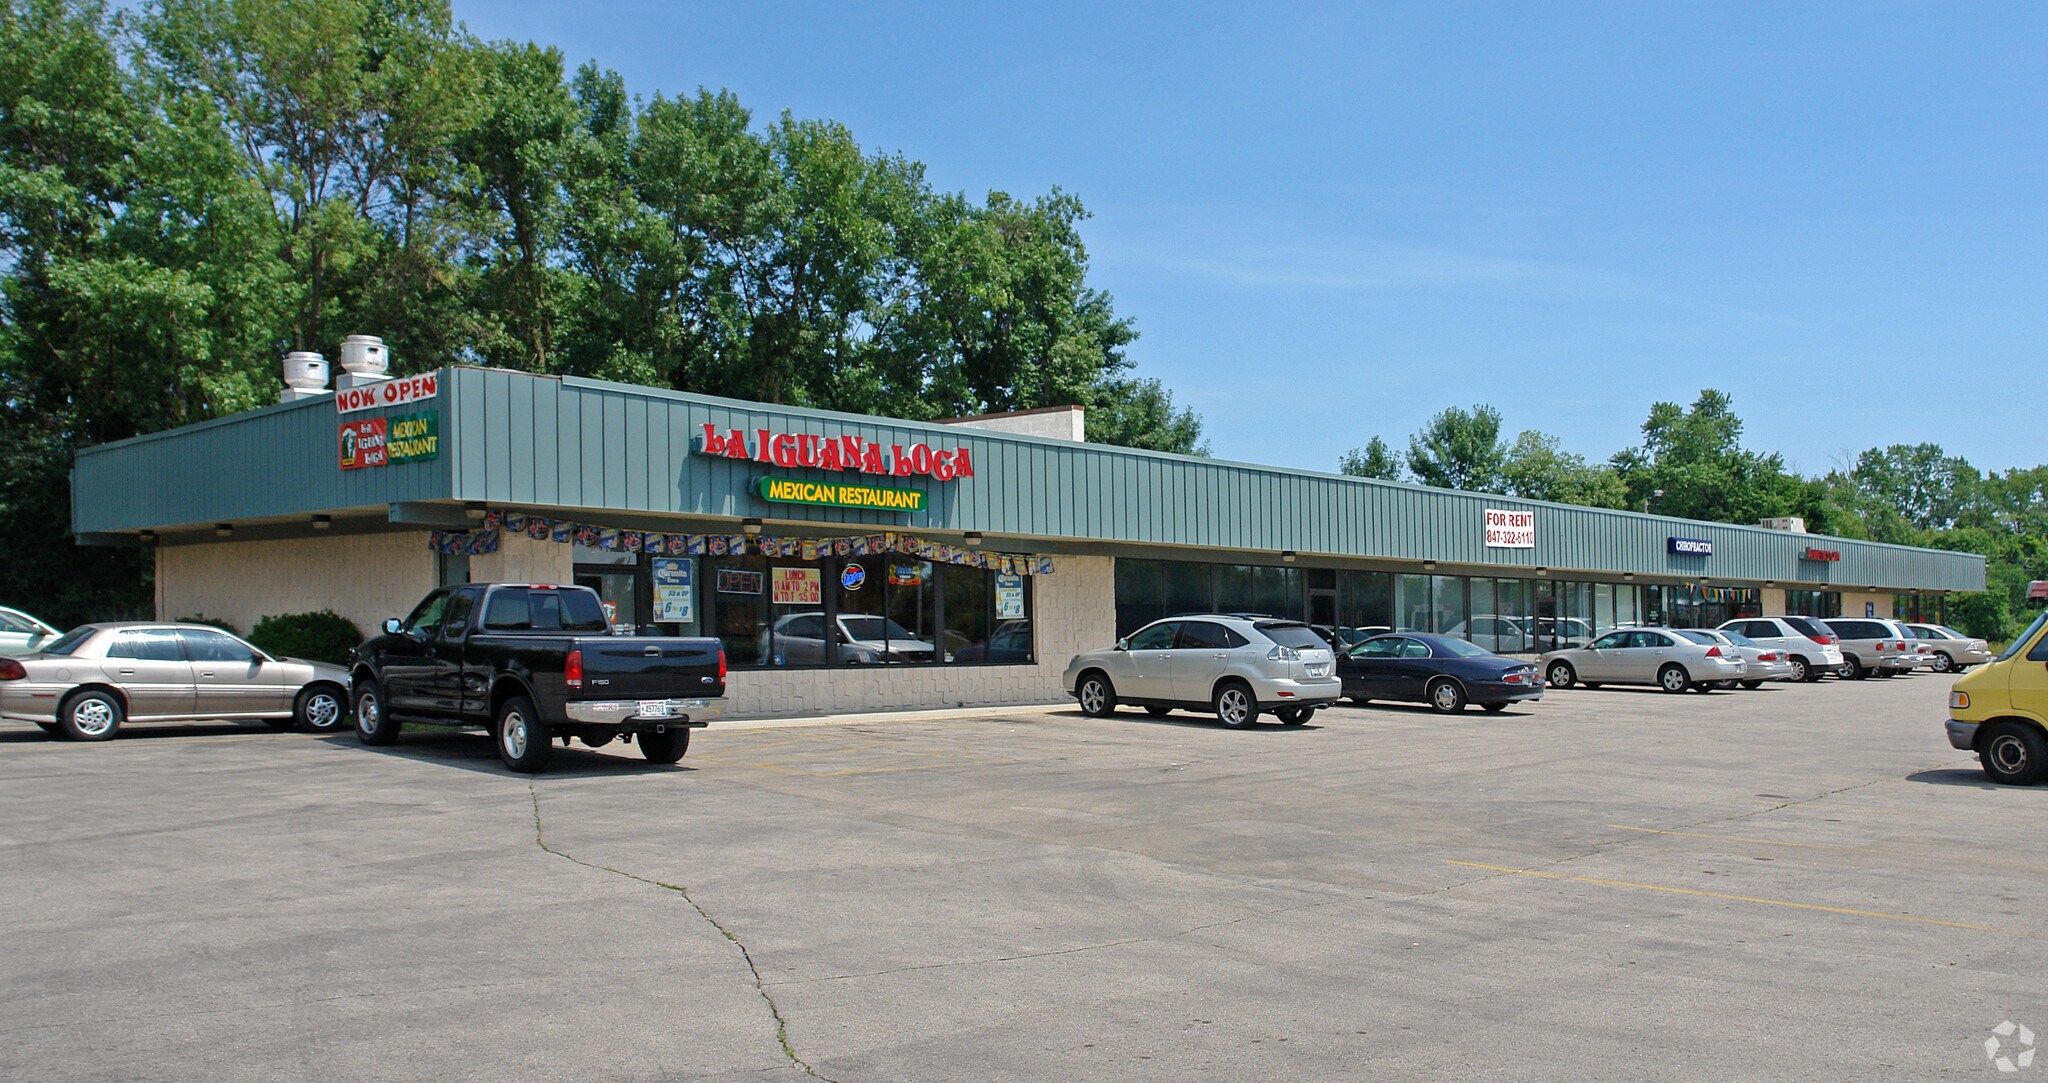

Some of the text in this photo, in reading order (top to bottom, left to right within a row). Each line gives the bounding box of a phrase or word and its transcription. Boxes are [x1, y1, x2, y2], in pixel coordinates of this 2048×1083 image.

[337, 376, 436, 411] NOW OPEN
[392, 417, 427, 439] MEXICAN
[386, 436, 438, 458] RESTAURANT
[699, 423, 974, 481] LA IGUANA LOCA
[769, 480, 921, 510] MEXICAN RESTAURANT
[1486, 512, 1532, 527] FOR RENT
[1675, 540, 1712, 553] CHIROPRACTOR
[719, 571, 761, 593] OPEN
[785, 570, 806, 580] LUNCH
[781, 580, 790, 591] AM
[791, 581, 800, 591] TO
[804, 581, 809, 591] 2
[809, 581, 820, 592] PM
[780, 592, 789, 602] TO
[664, 602, 673, 613] 6
